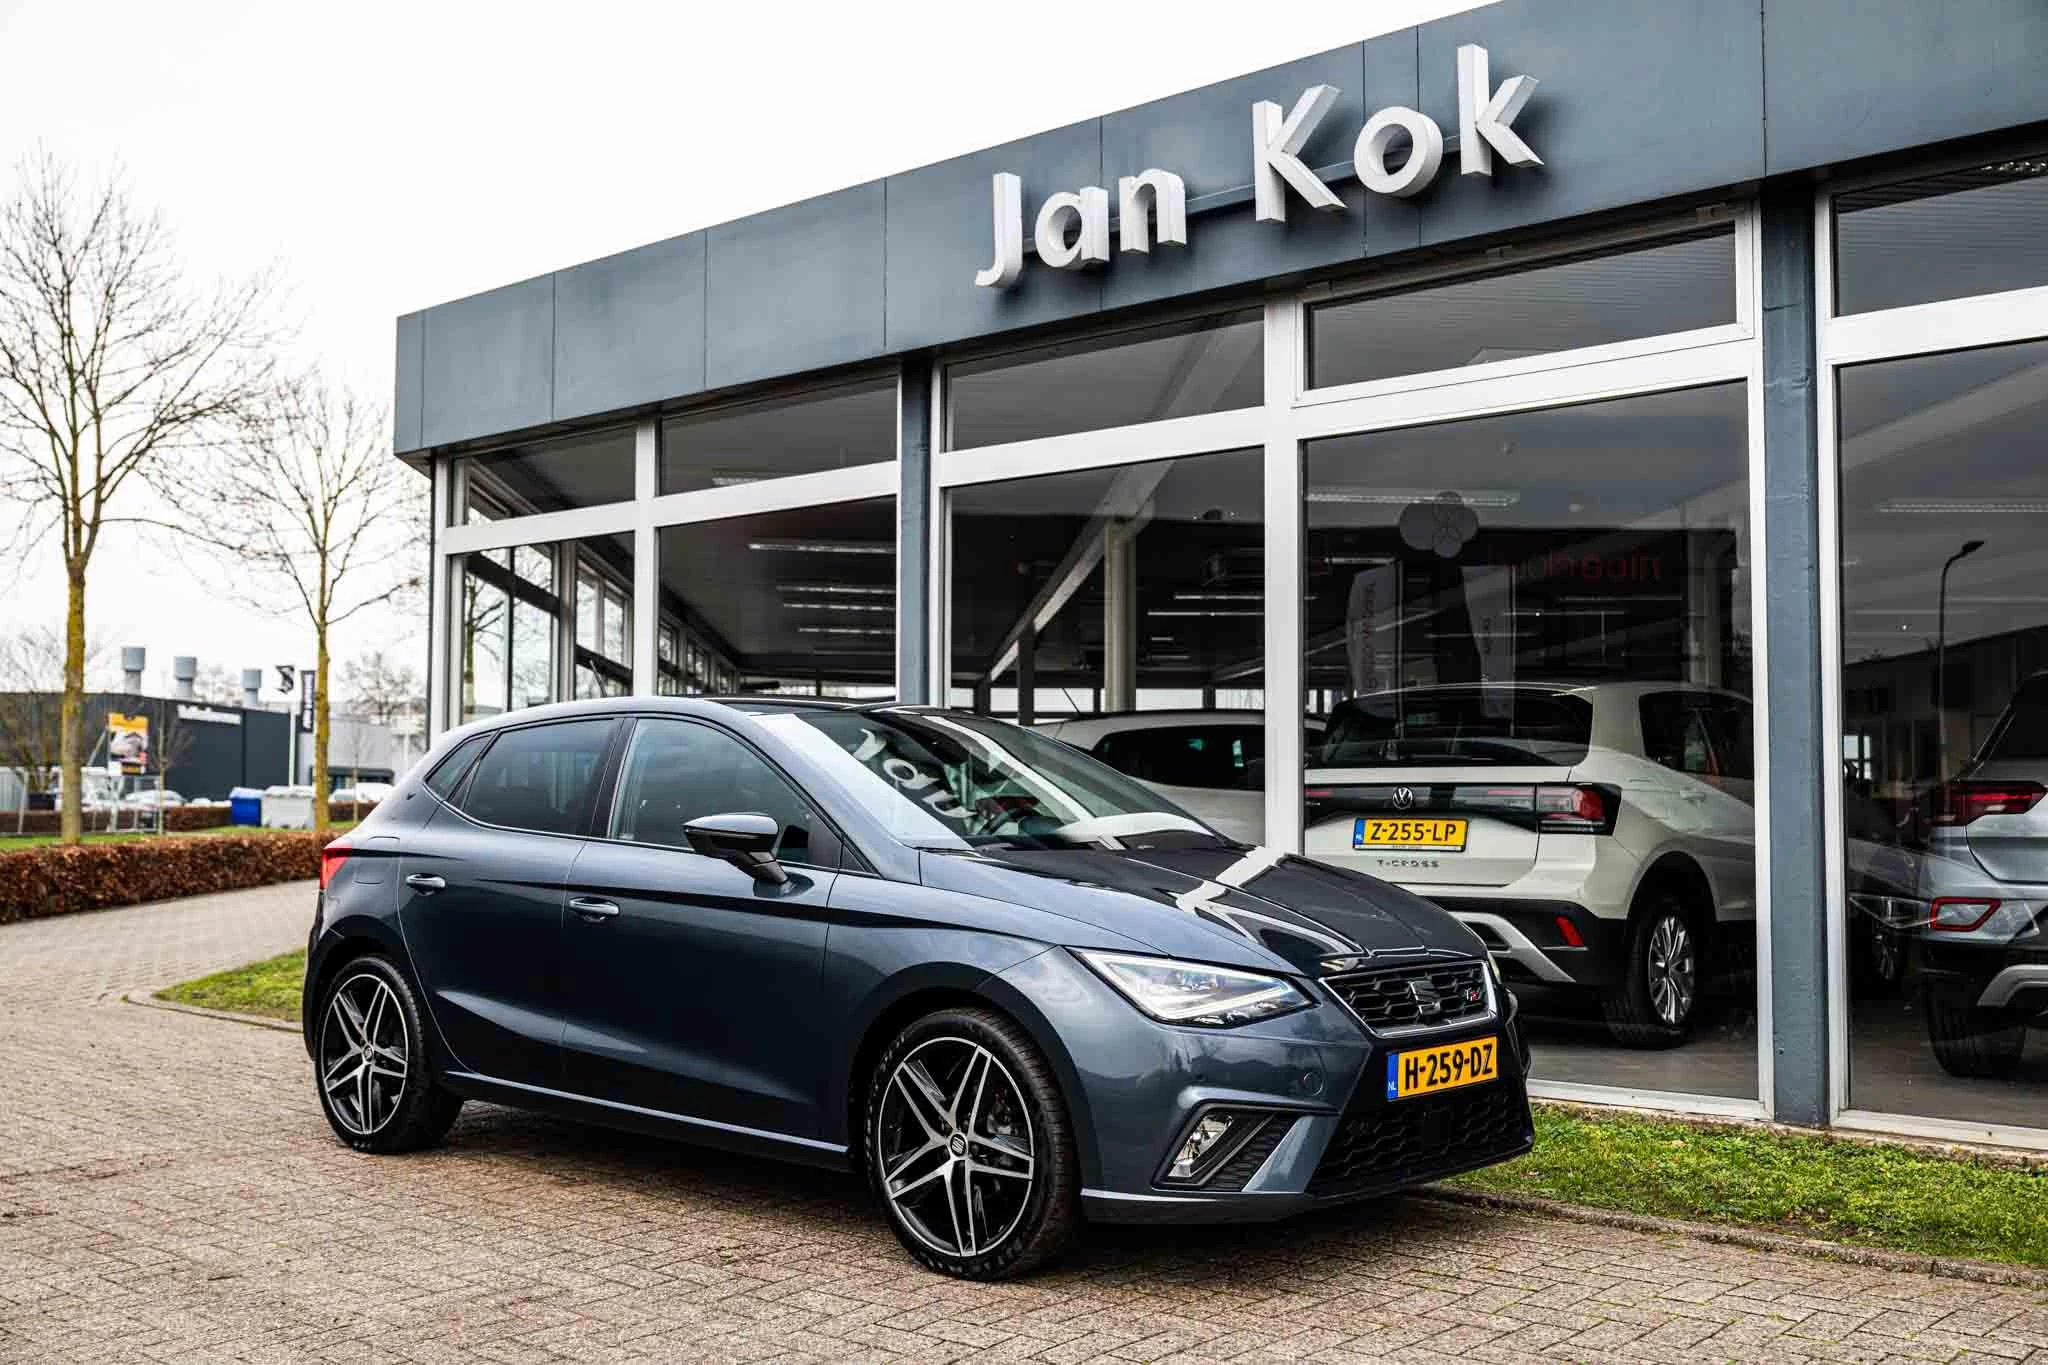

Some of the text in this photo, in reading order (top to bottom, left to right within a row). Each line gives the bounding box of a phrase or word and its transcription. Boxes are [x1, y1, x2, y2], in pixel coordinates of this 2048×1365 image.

[975, 43, 1544, 288] Jan Kok
[1371, 822, 1457, 841] Z-255-LP
[1405, 1043, 1493, 1091] H-259-DZ
